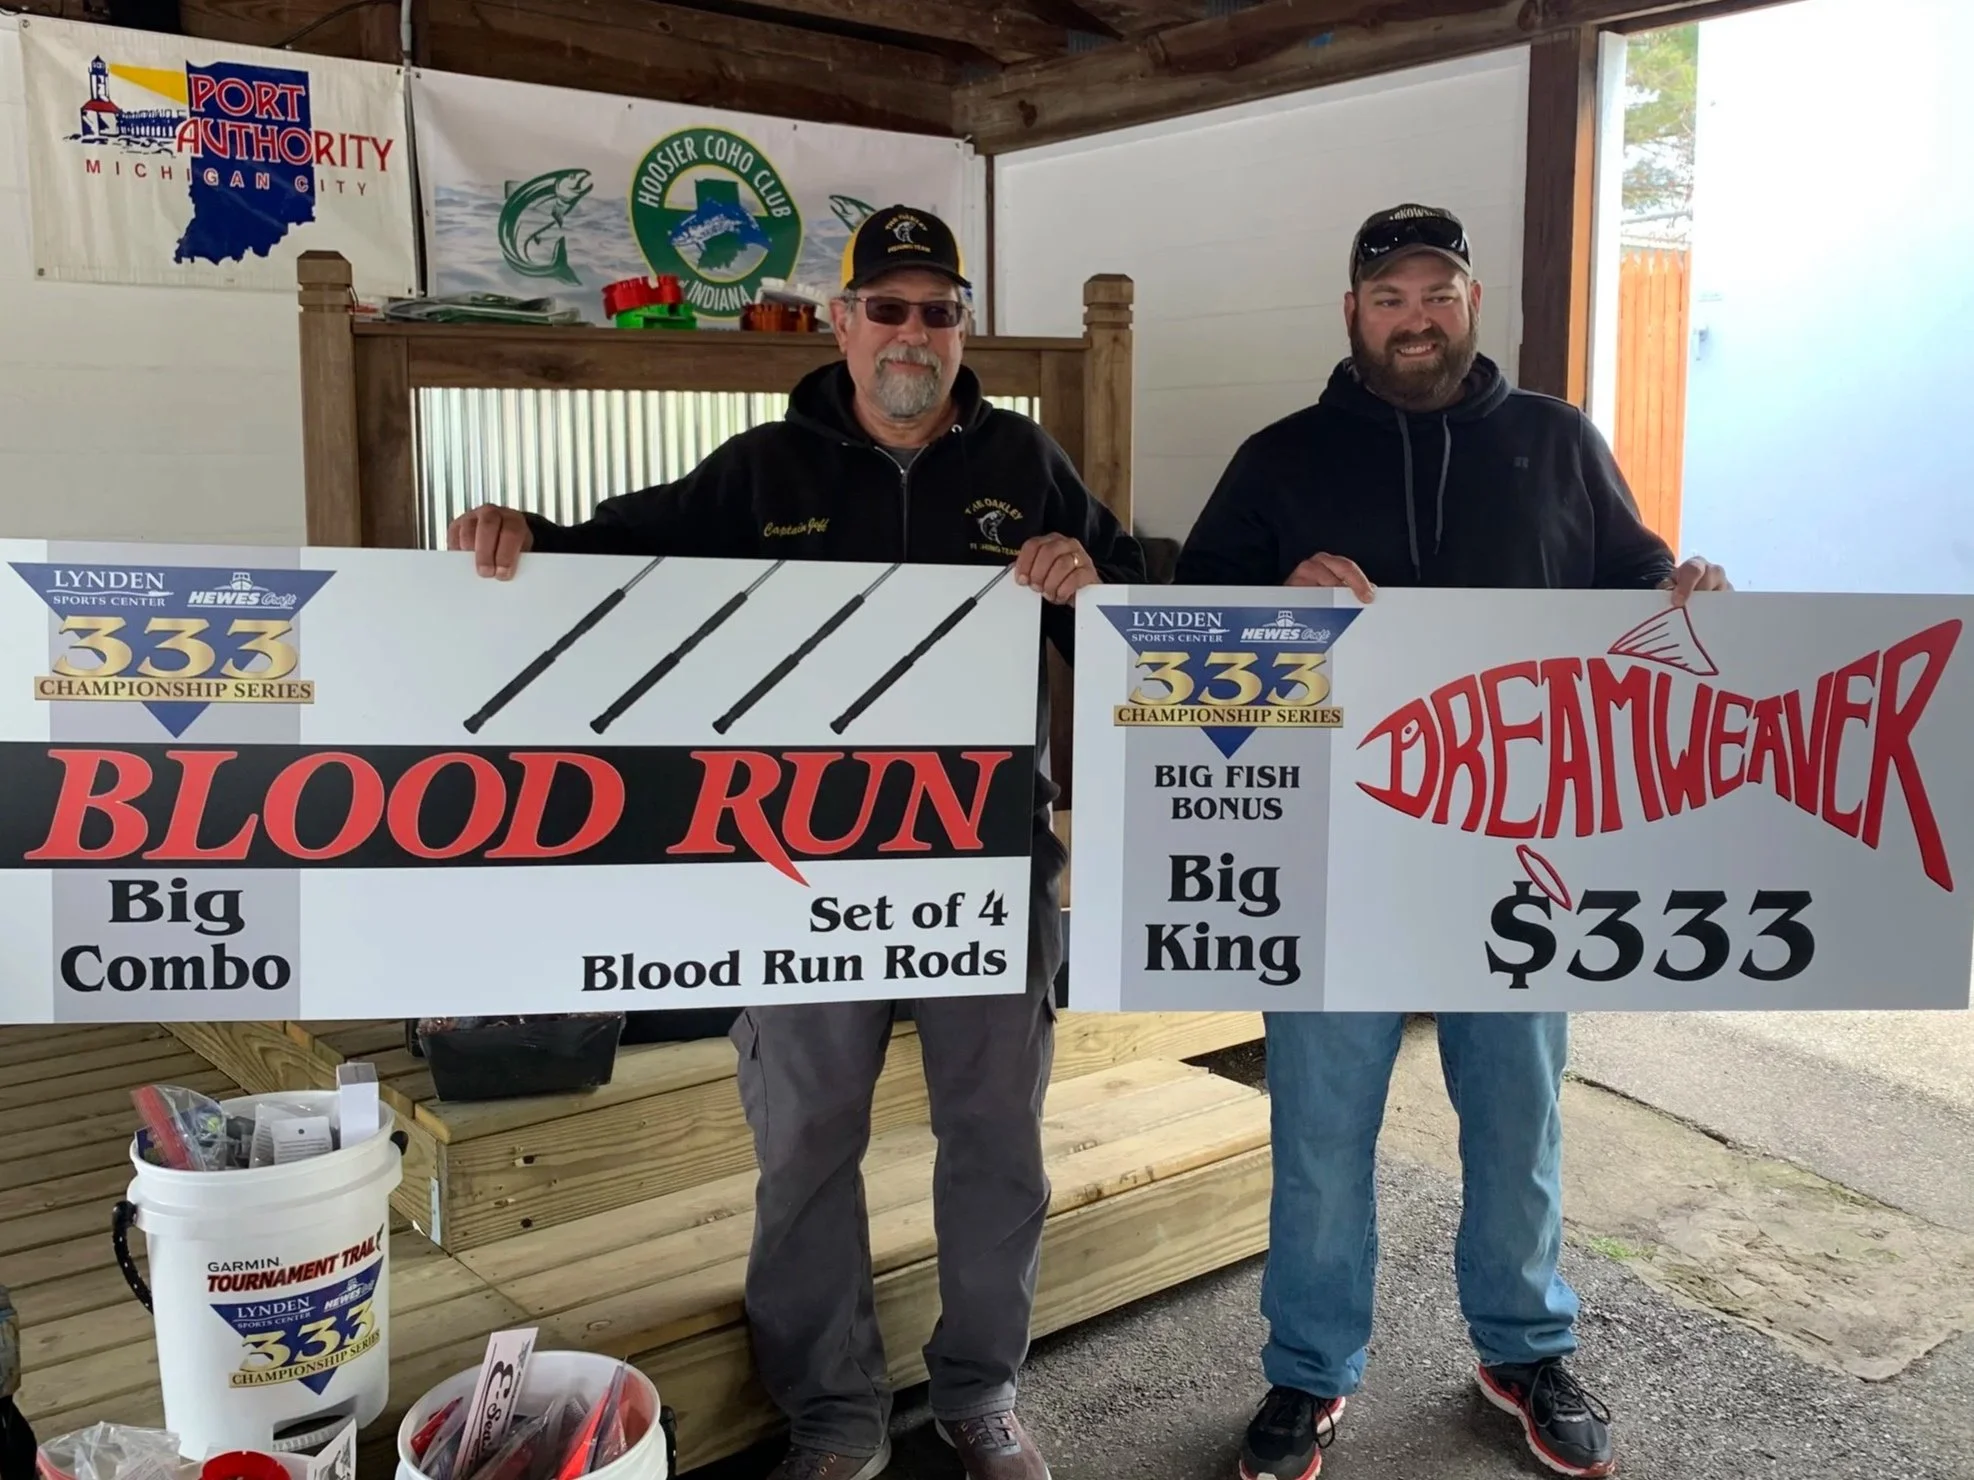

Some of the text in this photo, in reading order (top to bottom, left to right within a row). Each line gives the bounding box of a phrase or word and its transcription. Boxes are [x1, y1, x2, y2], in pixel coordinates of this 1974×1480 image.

[189, 72, 305, 122] PORT
[176, 118, 394, 172] AUTHORITY
[85, 159, 368, 197] MICHIGAN CITY
[637, 135, 792, 218] HOOSIER COHO CLUB
[687, 280, 753, 311] INDIANA
[984, 498, 1023, 520] OAKLEY
[764, 522, 807, 537] Captain
[54, 570, 165, 590] LYNDEN
[188, 591, 260, 605] HEWES
[53, 595, 166, 607] SPORTS CENTER
[1132, 611, 1223, 628] LYNDEN
[52, 615, 298, 679] 333
[1131, 633, 1223, 643] SPORTS CENTER
[1241, 628, 1301, 640] HEWES
[39, 680, 312, 699] CHAMPIONSHIP SERIES
[1128, 651, 1331, 707] 333
[1118, 708, 1341, 724] CHAMPIONSHIP SERIES
[1356, 618, 1963, 892] DREAMWEAVER
[1154, 765, 1300, 788] BIG FISH
[24, 748, 1013, 888] BLOOD RUN
[1171, 797, 1283, 820] BONUS
[1167, 852, 1281, 918] Big
[108, 877, 245, 936] Big
[810, 889, 1009, 932] Set of 4
[1144, 921, 1301, 986] King
[1484, 880, 1816, 989] $333
[60, 943, 291, 992] Combo
[581, 940, 1008, 991] Blood Run Rods
[207, 1255, 339, 1292] TOURNAMENT
[341, 1235, 376, 1268] TRAIL
[207, 1257, 280, 1272] GARMIN
[237, 1296, 310, 1318] LYNDEN
[237, 1312, 311, 1329] SPORTS CENTER
[239, 1299, 375, 1371] 333
[232, 1330, 380, 1385] CHAMPIONSHIP SERIES
